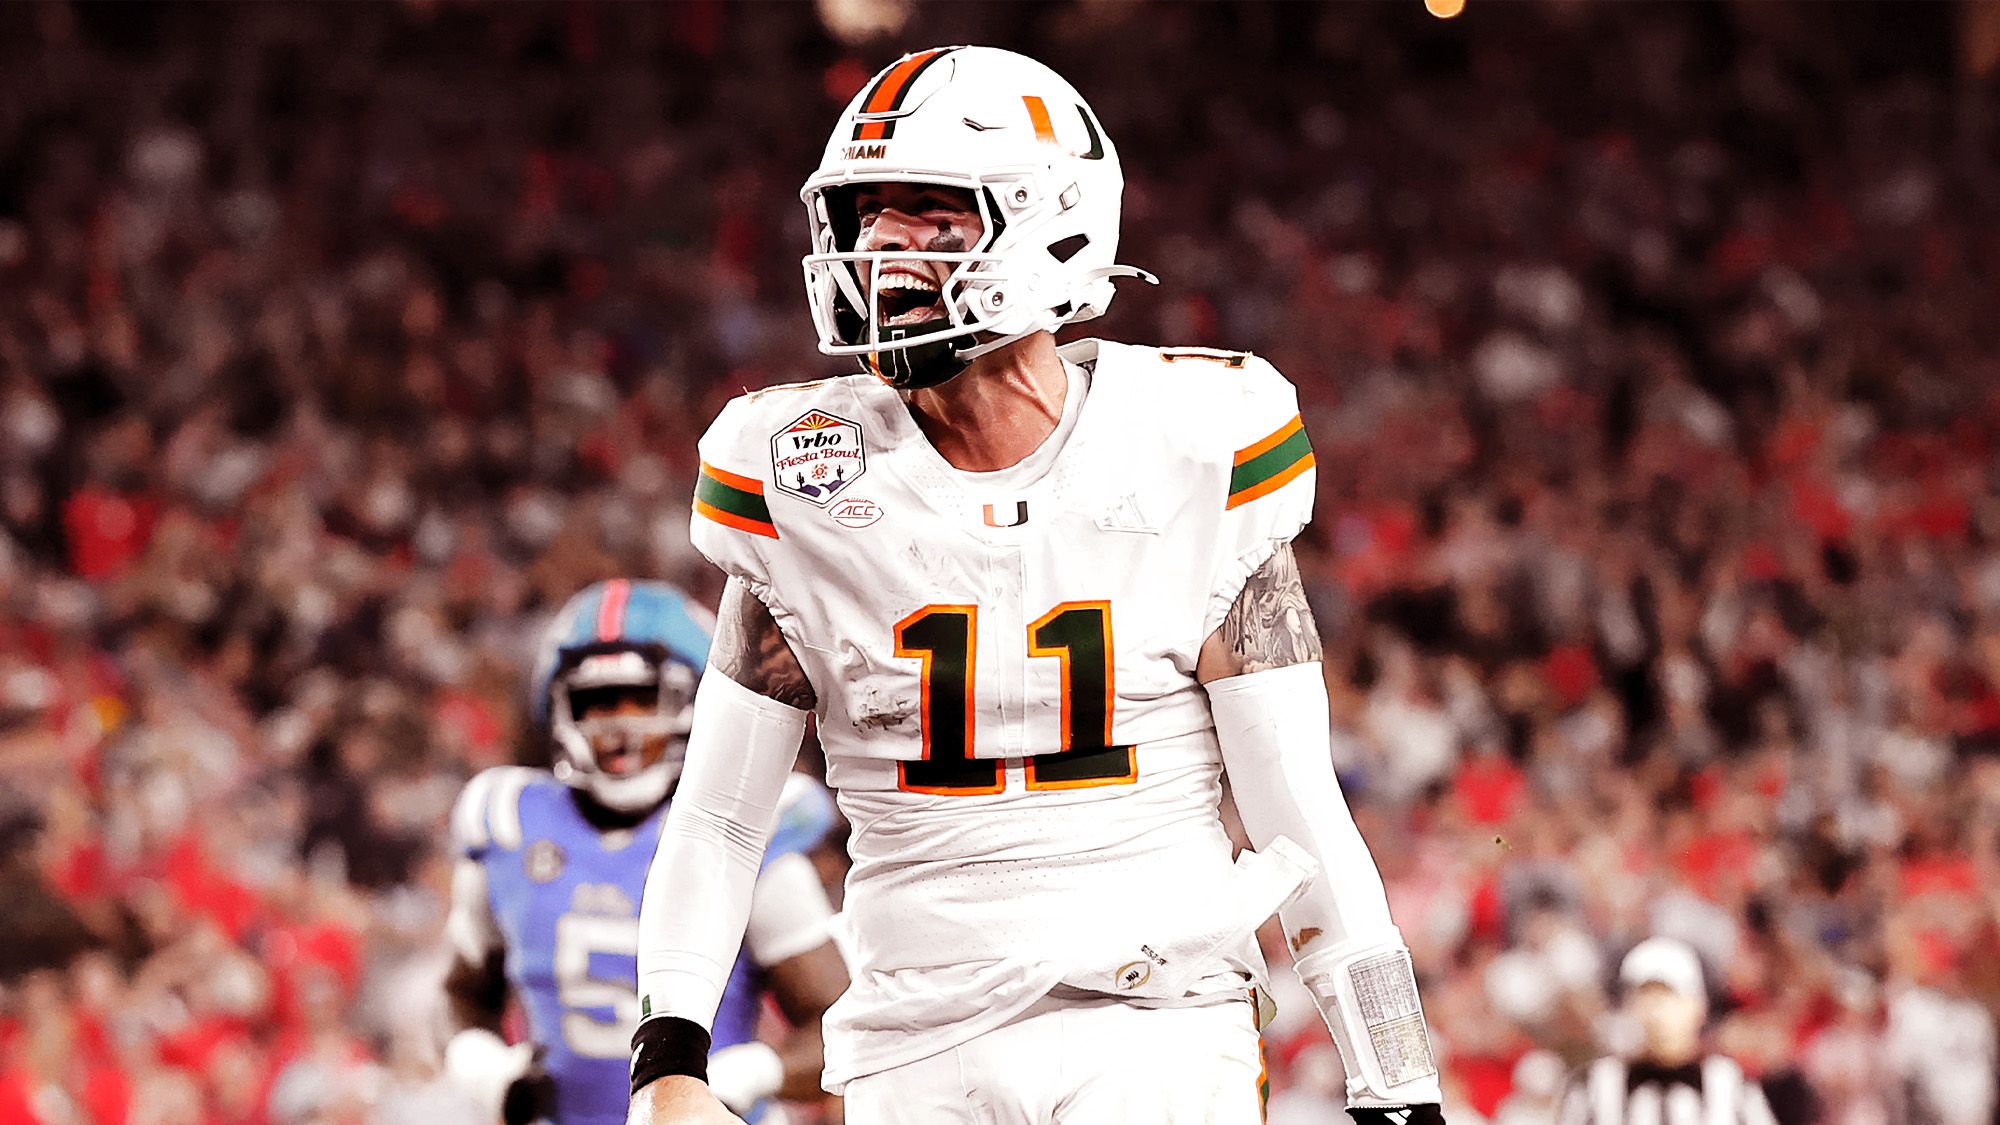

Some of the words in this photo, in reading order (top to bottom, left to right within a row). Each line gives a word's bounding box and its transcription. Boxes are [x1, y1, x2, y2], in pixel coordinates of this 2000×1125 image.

[793, 432, 841, 449] Vrbo
[776, 452, 819, 470] Fiesta
[820, 448, 861, 460] Bowl
[838, 505, 876, 516] ACC
[893, 600, 1138, 796] 11
[555, 913, 638, 1058] 5
